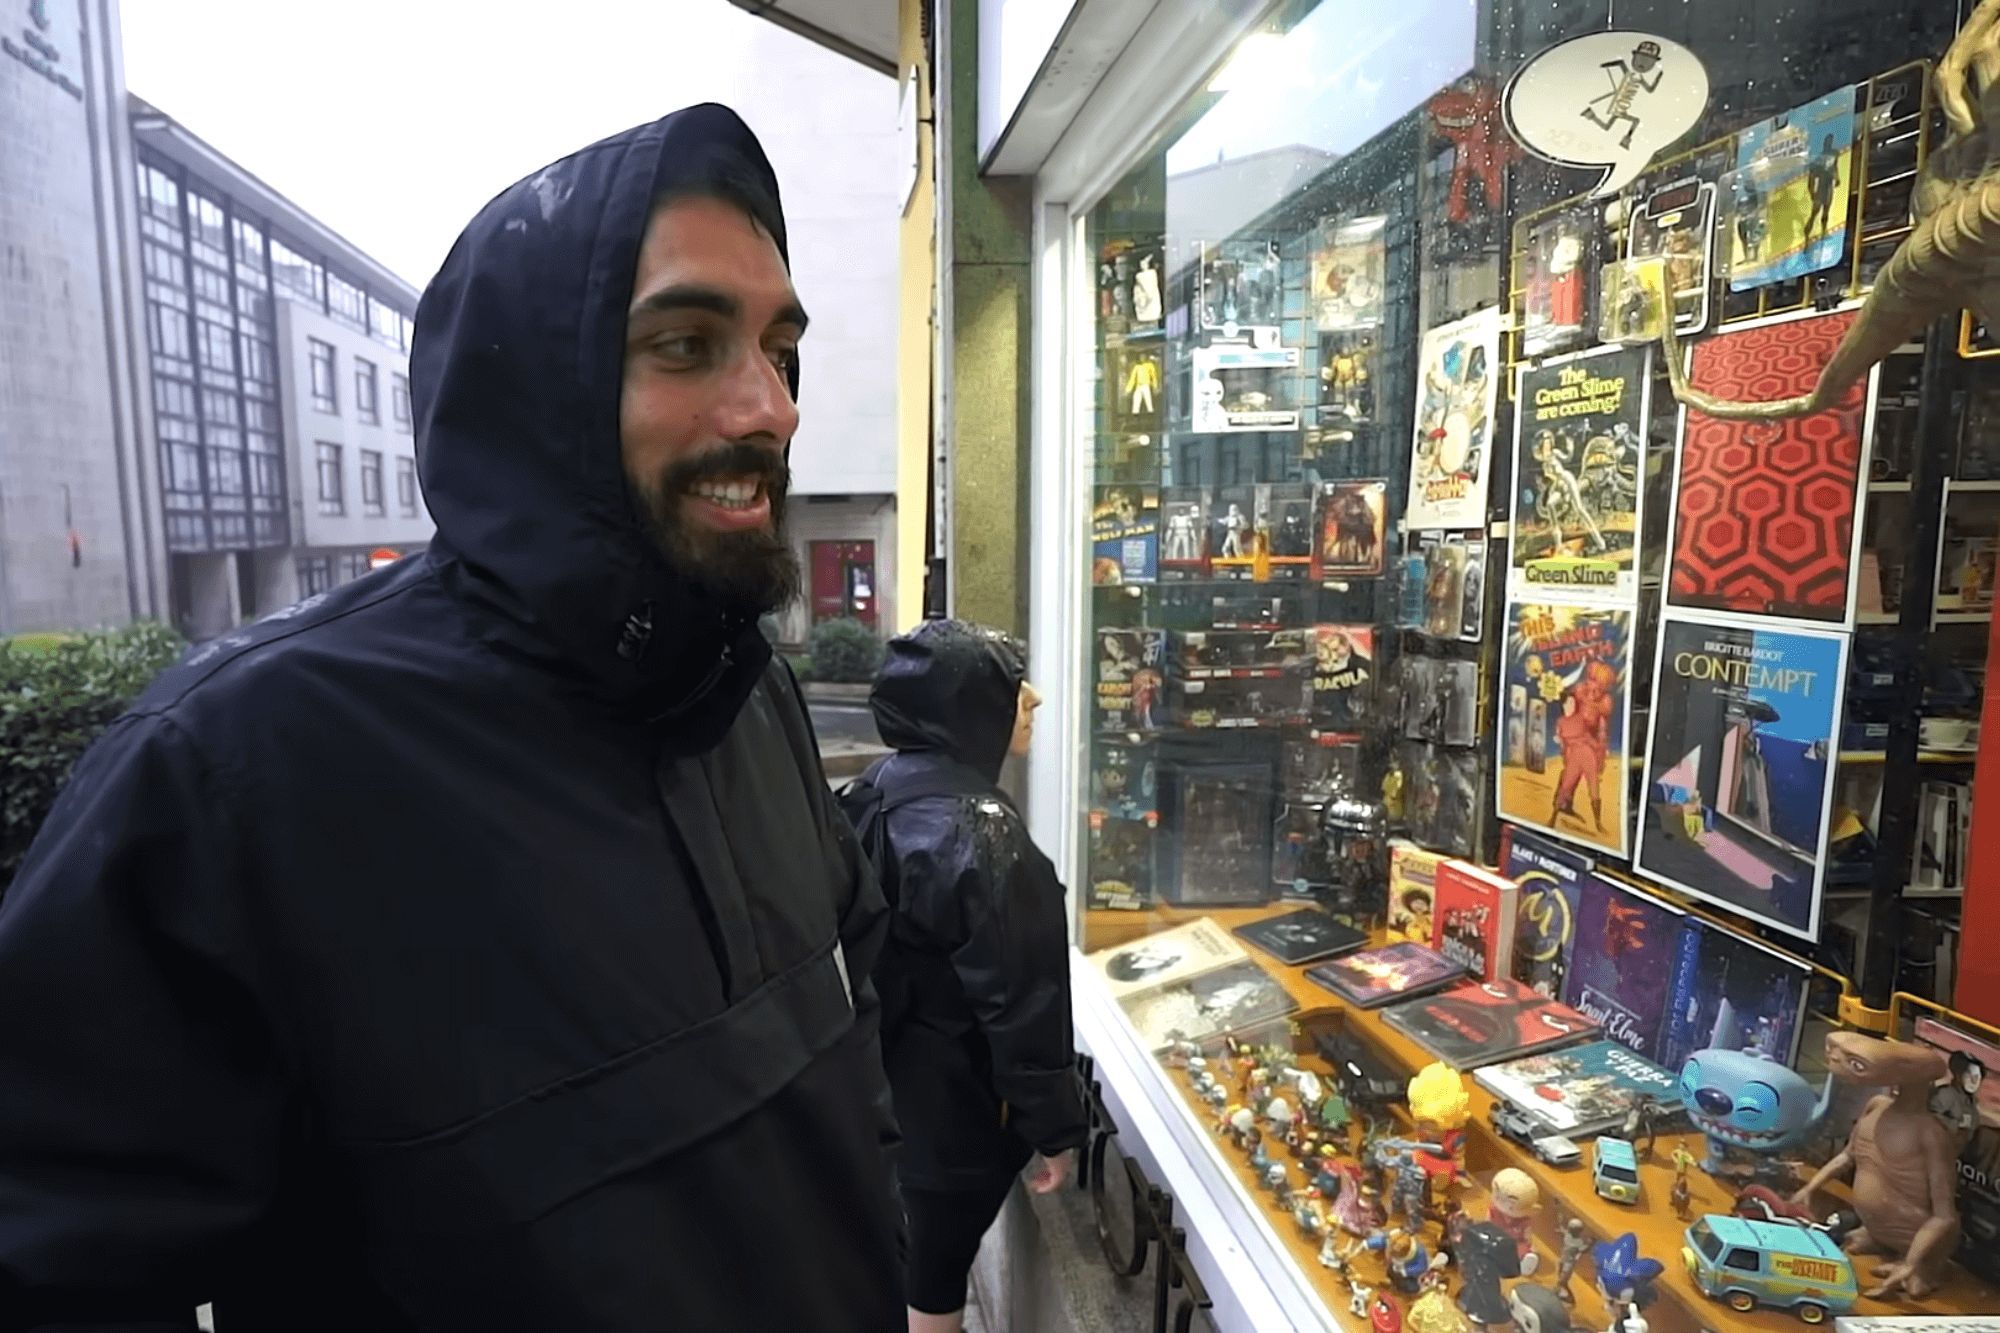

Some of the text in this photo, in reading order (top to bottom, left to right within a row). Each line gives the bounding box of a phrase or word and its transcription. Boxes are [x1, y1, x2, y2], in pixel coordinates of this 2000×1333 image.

[1558, 365, 1587, 385] The
[1535, 376, 1624, 405] Green Slime
[1535, 388, 1622, 420] are coming!
[1525, 564, 1616, 585] Green Slime
[1551, 640, 1614, 666] EARTH
[1743, 647, 1785, 662] BARDOT
[1674, 652, 1818, 697] CONTEMPT
